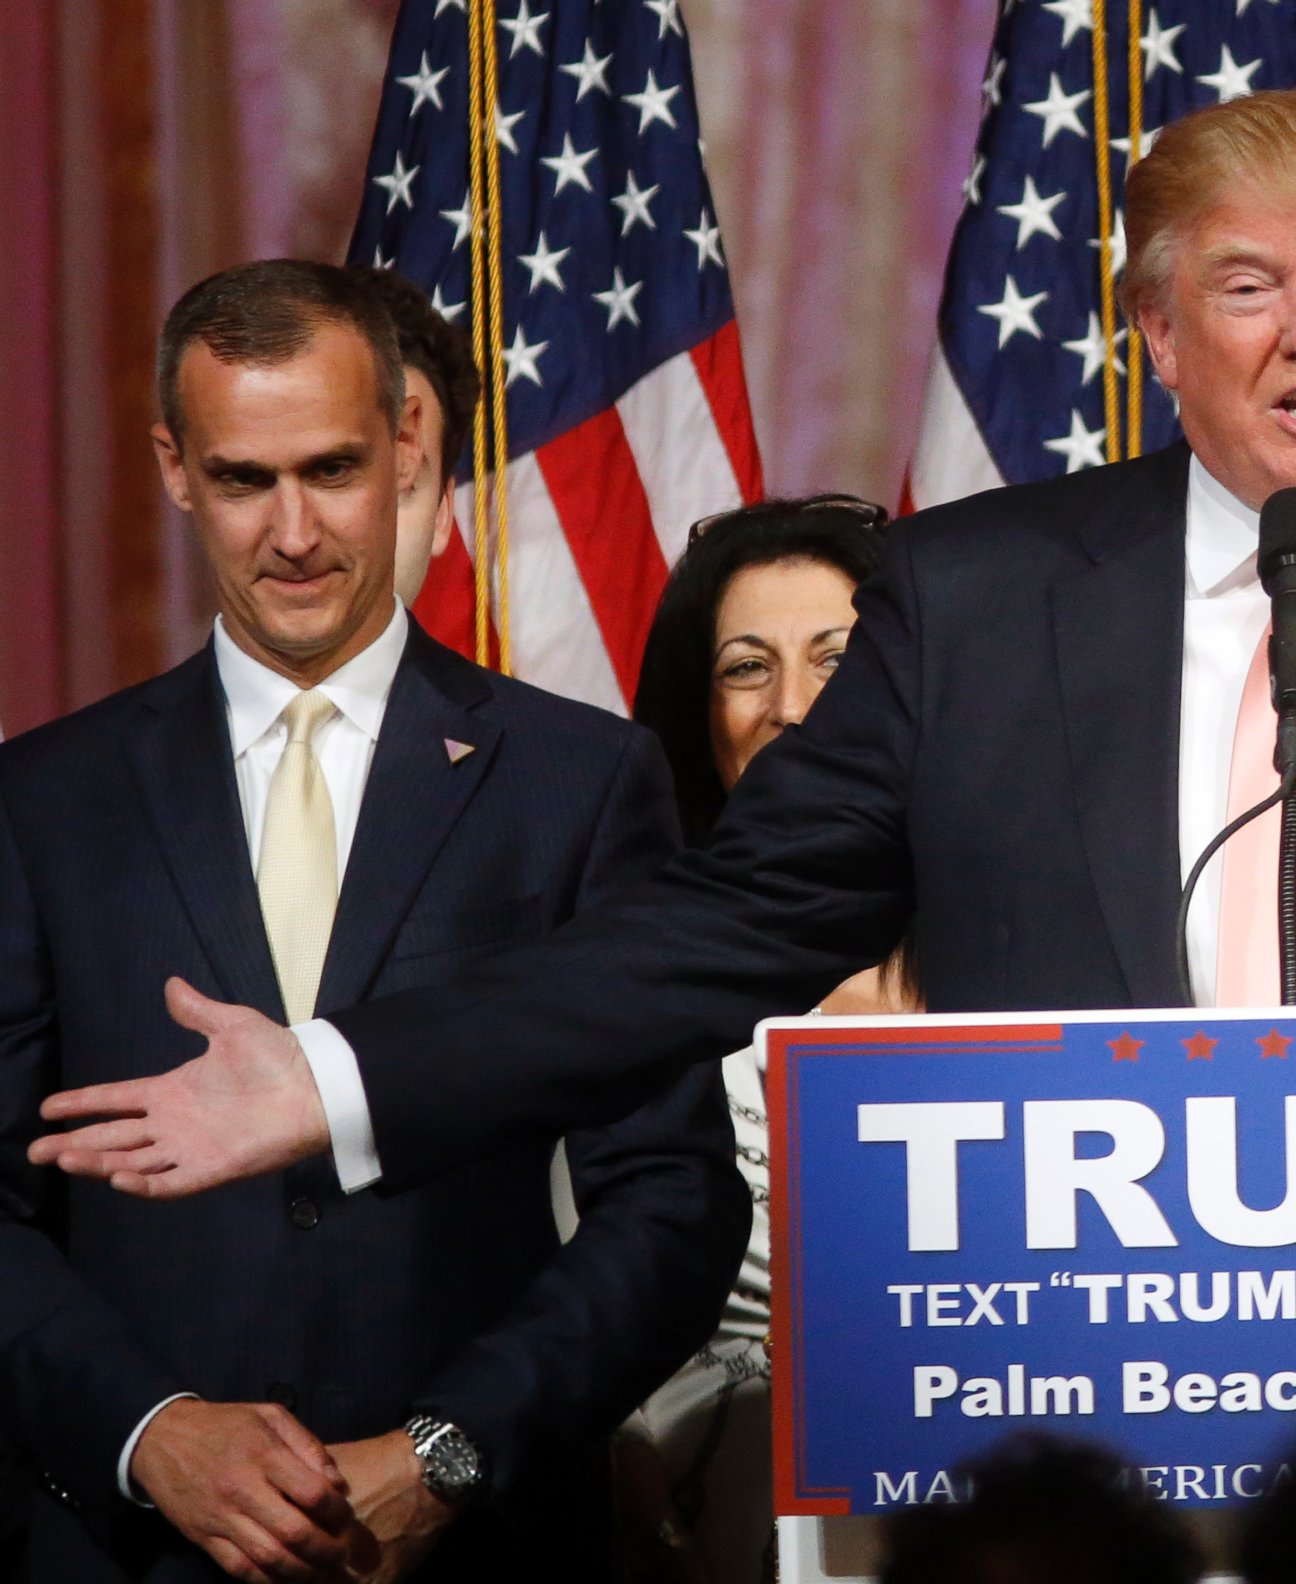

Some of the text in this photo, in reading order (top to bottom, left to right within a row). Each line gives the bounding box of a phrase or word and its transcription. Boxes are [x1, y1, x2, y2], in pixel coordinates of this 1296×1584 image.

[887, 1282, 1041, 1327] TEXT
[913, 1363, 1095, 1418] Palm
[873, 1470, 978, 1506] MA
